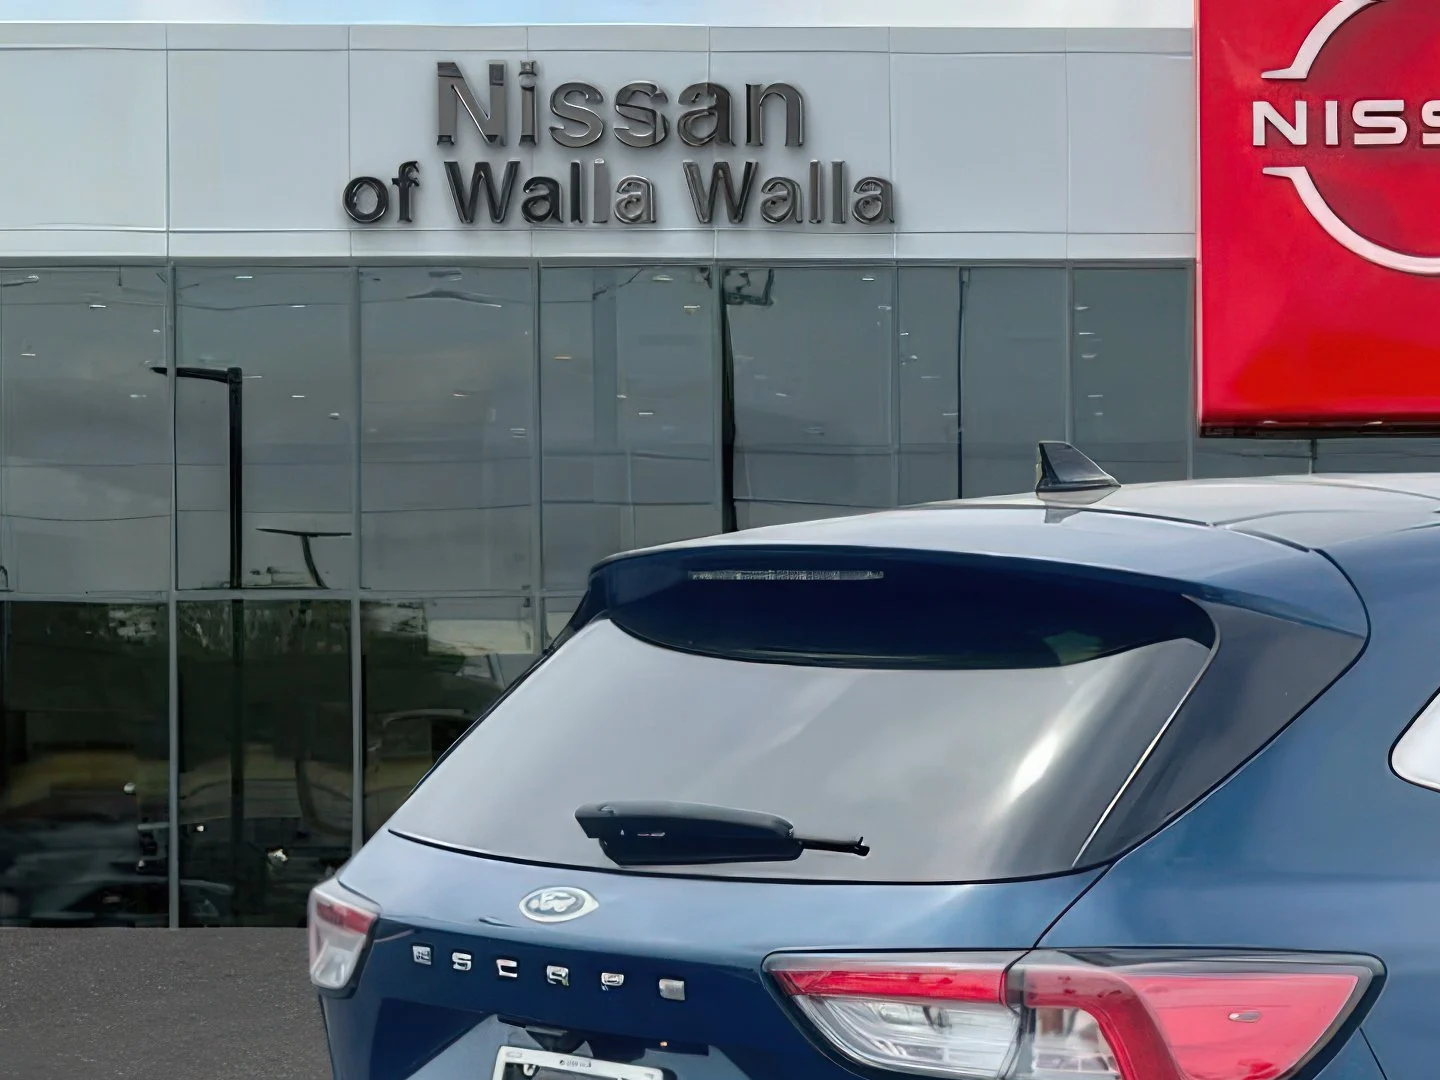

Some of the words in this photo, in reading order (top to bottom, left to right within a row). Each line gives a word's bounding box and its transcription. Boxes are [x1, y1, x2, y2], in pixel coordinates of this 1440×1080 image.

[436, 60, 804, 147] Nissan
[342, 159, 421, 224] of
[444, 159, 657, 225] Walla
[683, 159, 896, 225] Walla
